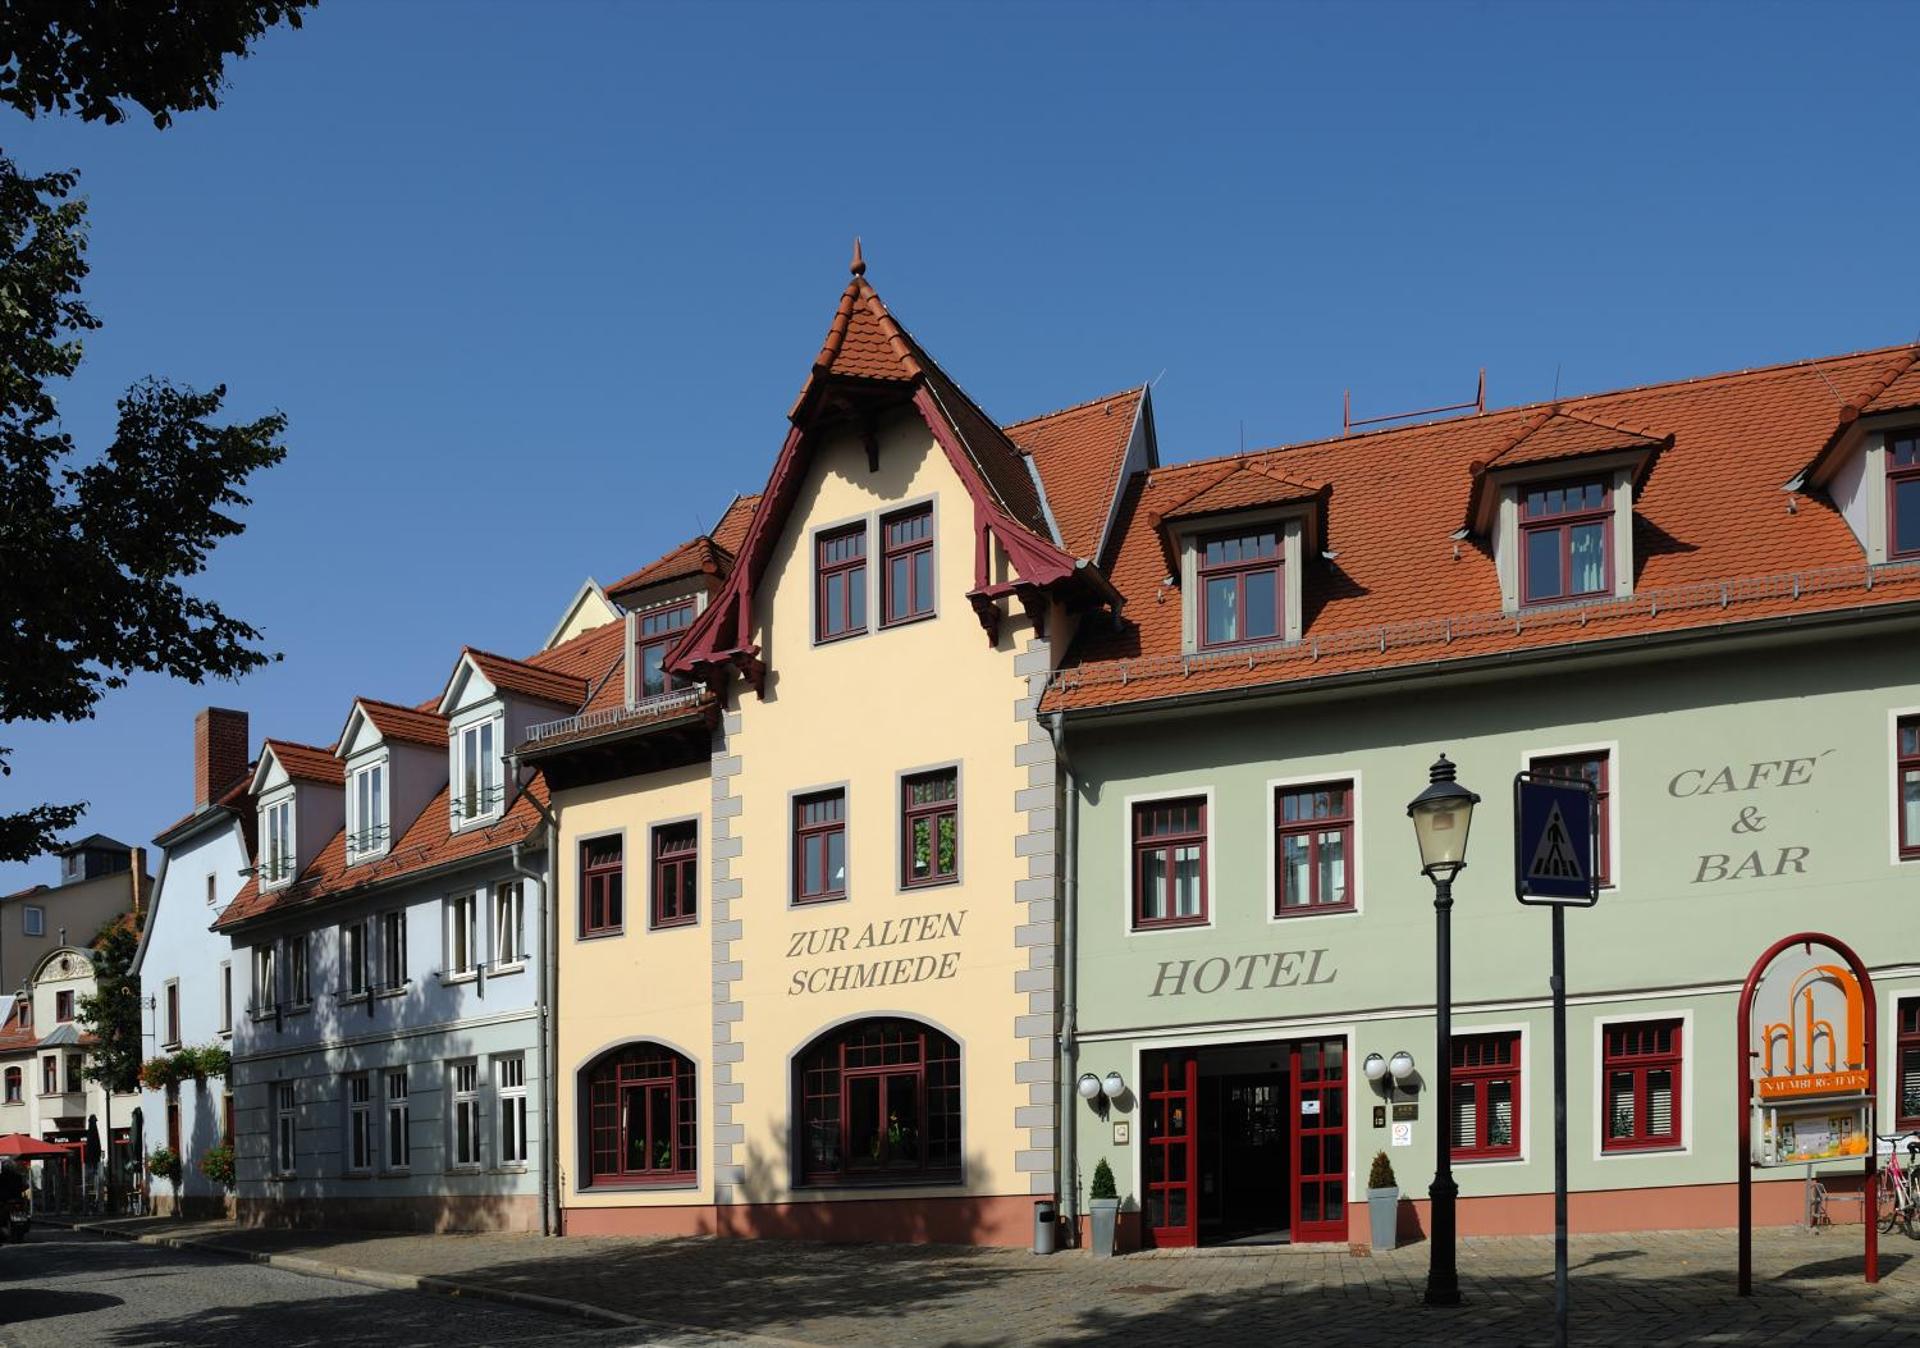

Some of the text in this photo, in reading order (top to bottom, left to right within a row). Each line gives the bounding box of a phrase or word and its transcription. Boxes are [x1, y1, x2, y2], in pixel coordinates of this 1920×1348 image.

[1731, 806, 1767, 834] &
[1690, 846, 1810, 884] BAR
[786, 910, 969, 958] ZUR ALTEN
[787, 951, 962, 996] SCHMIEDE
[1147, 948, 1338, 998] HOTEL
